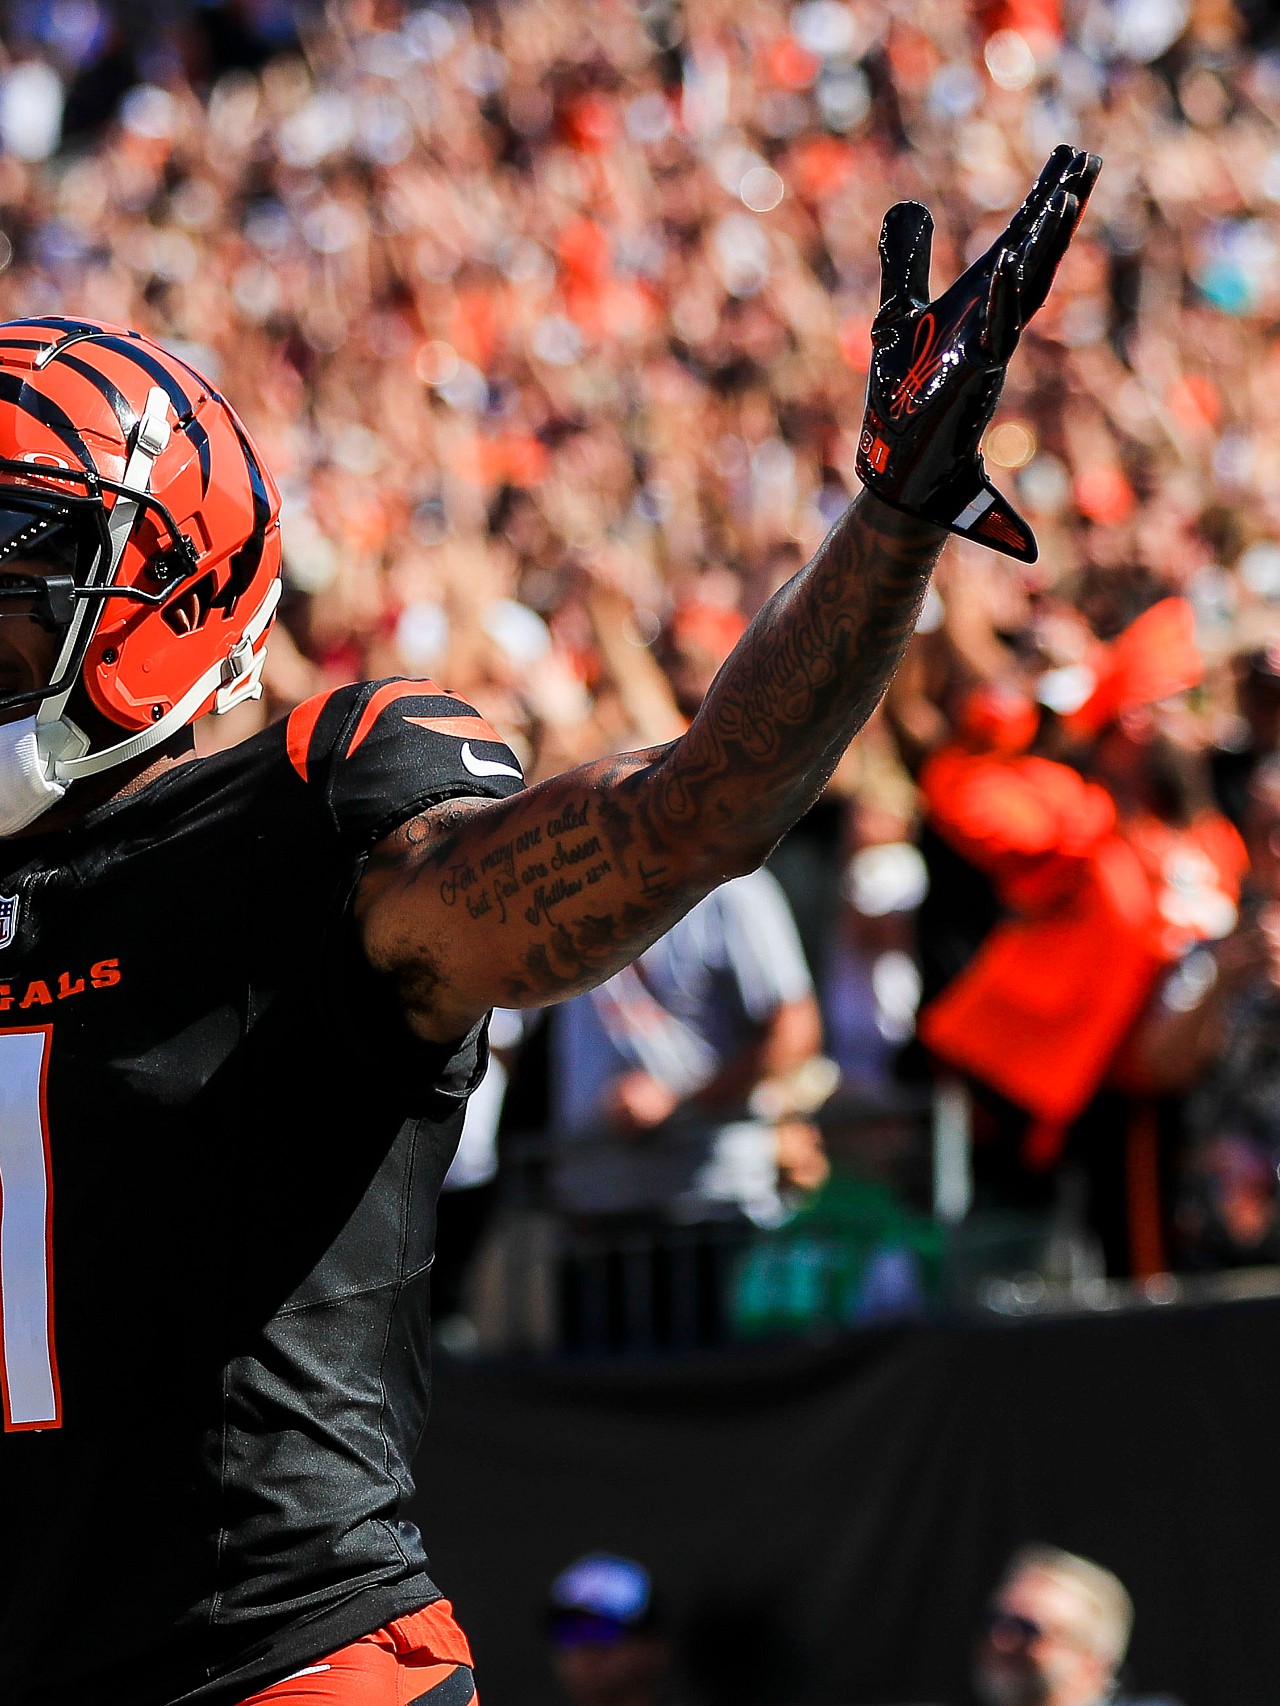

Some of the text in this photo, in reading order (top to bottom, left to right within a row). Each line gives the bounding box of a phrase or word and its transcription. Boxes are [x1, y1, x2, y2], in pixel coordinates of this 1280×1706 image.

[516, 826, 542, 854] are
[547, 799, 589, 839] called
[465, 887, 493, 920] but
[522, 862, 549, 886] are
[551, 836, 604, 871] chosen
[525, 877, 584, 928] Matthew
